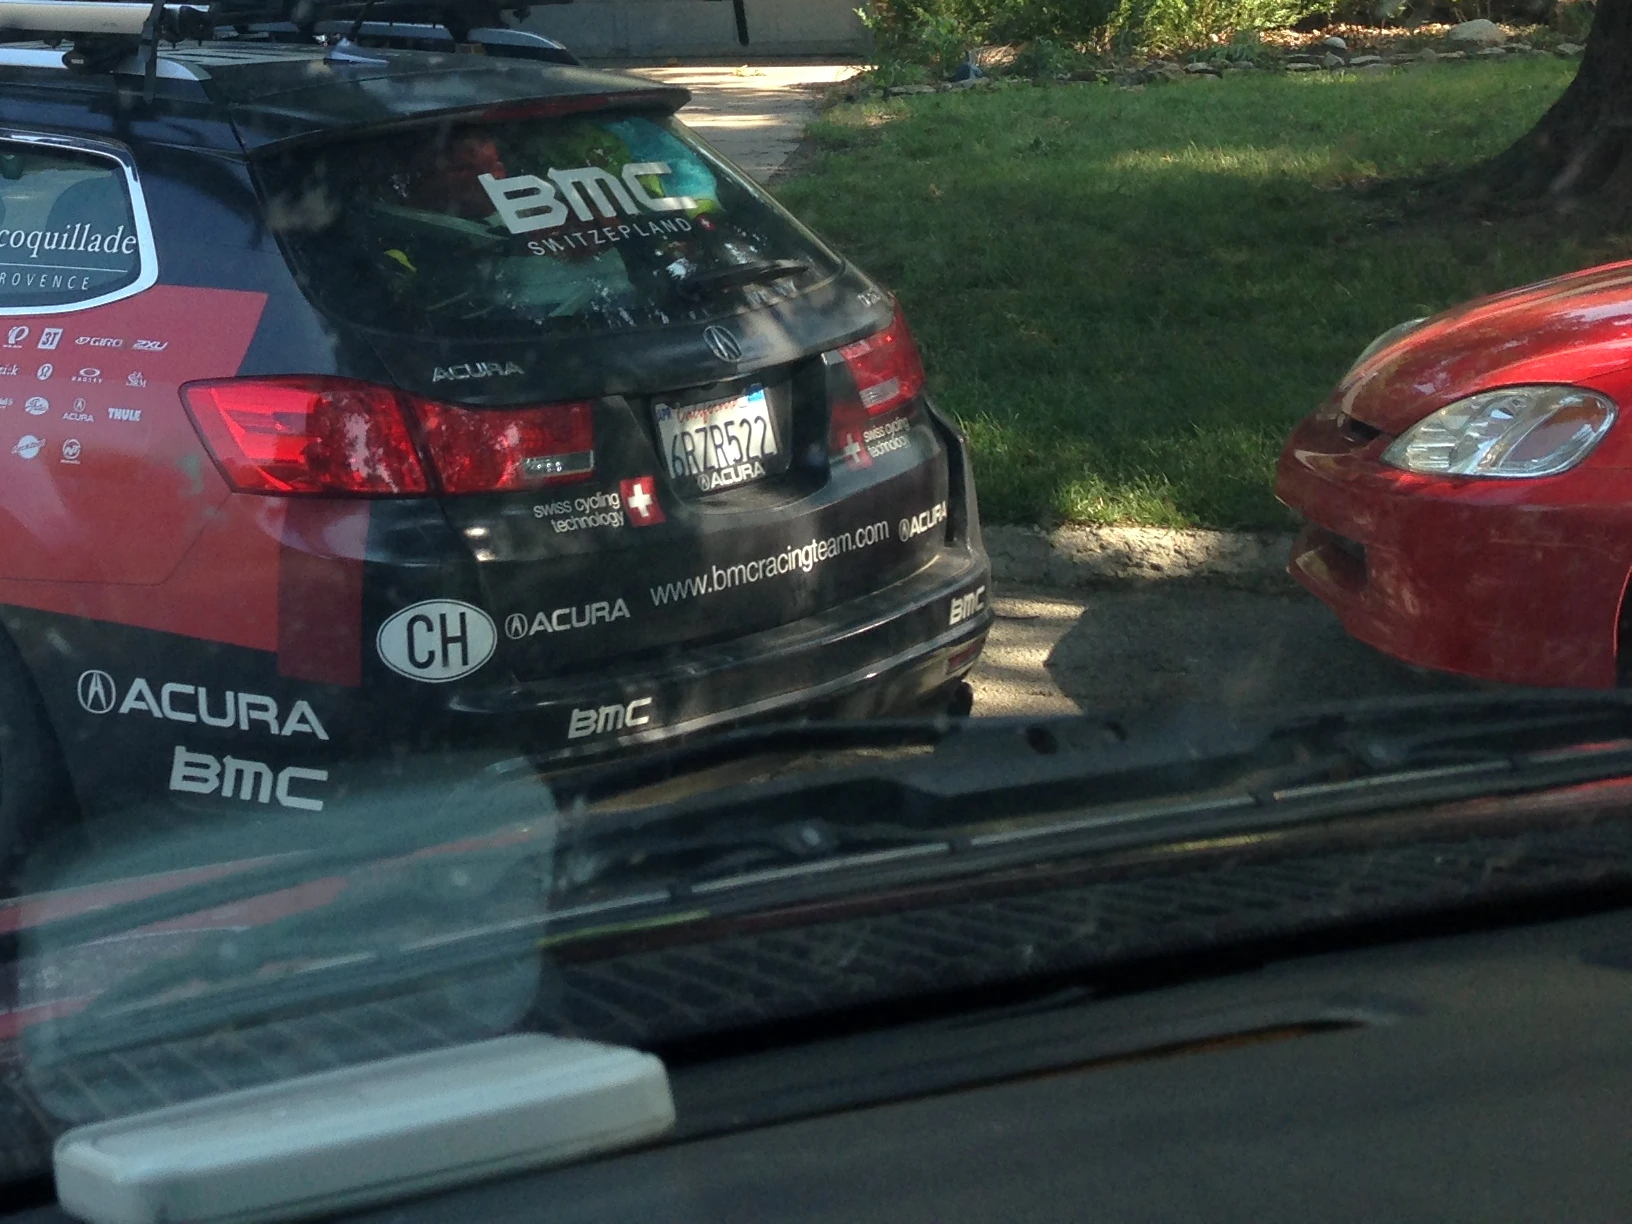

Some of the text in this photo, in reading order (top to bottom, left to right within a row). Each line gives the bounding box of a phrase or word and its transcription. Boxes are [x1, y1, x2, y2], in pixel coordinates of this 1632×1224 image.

[478, 162, 698, 235] BMC
[41, 331, 61, 347] 3T
[89, 337, 123, 347] GIRO
[432, 361, 525, 383] ACURA
[62, 412, 95, 423] ACURA
[108, 407, 143, 422] THULE
[671, 415, 776, 477] 6RZR522
[711, 461, 766, 488] ACURA
[533, 491, 622, 519] swiss cycling
[551, 509, 626, 534] technology
[909, 501, 948, 537] ACURA
[649, 519, 890, 607] www.bmcracingteam.com
[528, 598, 631, 636] ACURA
[949, 585, 986, 626] BMC
[406, 612, 469, 670] CH
[118, 677, 330, 741] ACURA
[568, 696, 652, 740] BMC
[169, 745, 329, 812] BMC
